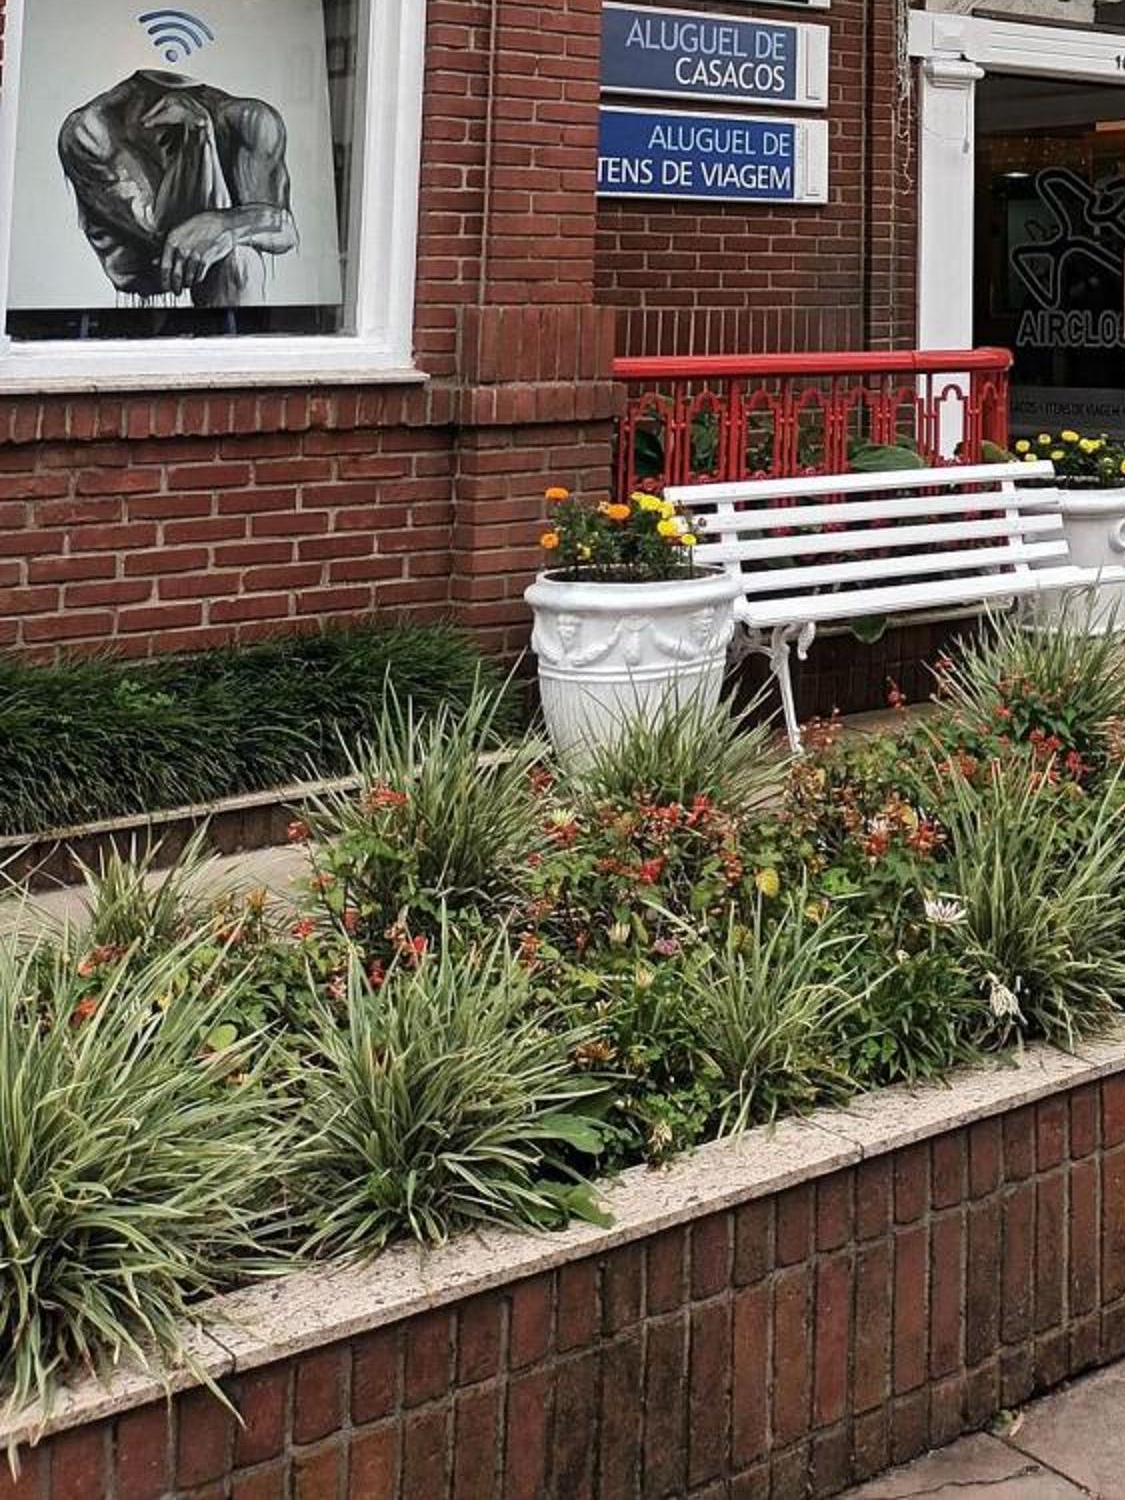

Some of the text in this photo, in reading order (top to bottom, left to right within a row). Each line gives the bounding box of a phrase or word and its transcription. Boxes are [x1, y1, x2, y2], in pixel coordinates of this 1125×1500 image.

[625, 18, 787, 61] ALUGUEL DE
[675, 57, 786, 93] CASACOS
[648, 125, 792, 157] ALUGUEL DE
[662, 159, 693, 186] DE
[701, 162, 792, 191] VIAGEM
